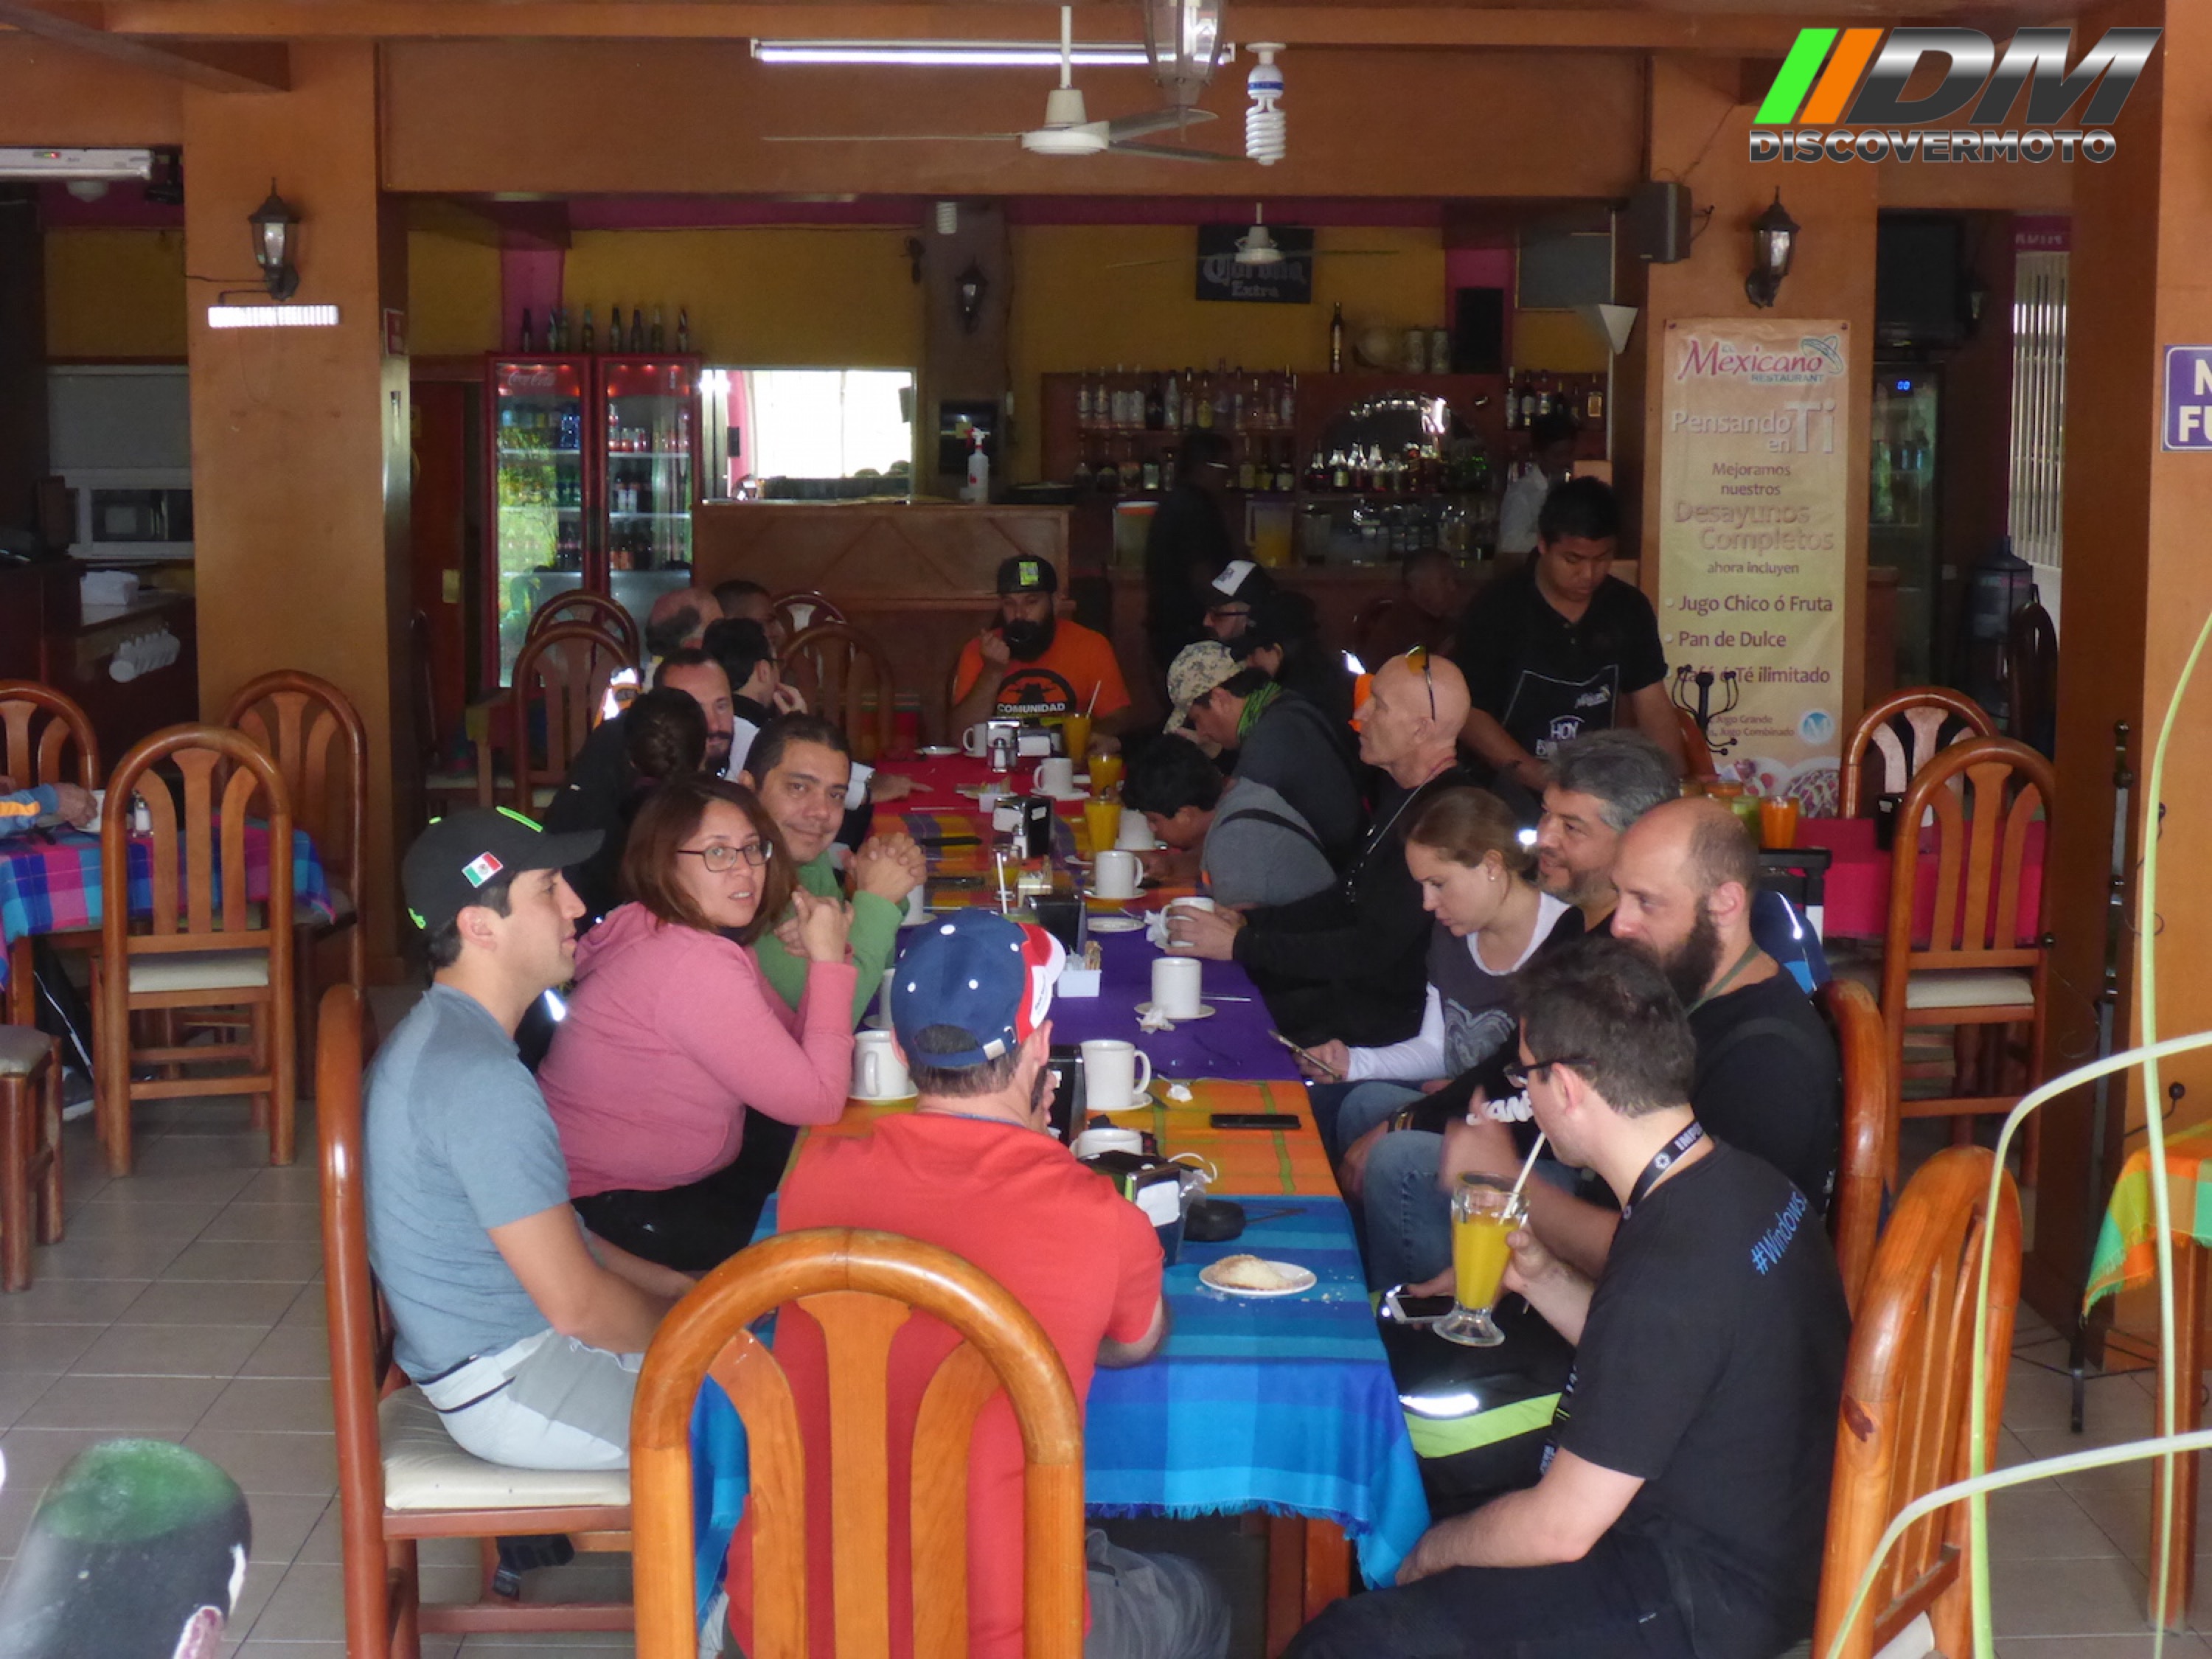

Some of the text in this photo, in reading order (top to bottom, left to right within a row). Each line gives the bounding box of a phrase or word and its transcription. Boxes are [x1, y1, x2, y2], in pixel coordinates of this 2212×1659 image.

[1231, 280, 1279, 297] Extra
[1677, 338, 1823, 380] Mexicano
[1751, 374, 1824, 383] RESTAURANT
[1671, 398, 1837, 455] Pensando en Ti
[1711, 463, 1791, 479] Mejoramos
[1720, 484, 1781, 496] nuestros
[1674, 502, 1810, 527] Desayunos
[1700, 526, 1834, 556] Completos
[1707, 562, 1800, 577] ahora incluyen
[1678, 595, 1833, 615] Jugo Chico ó Fruta
[1678, 631, 1787, 647] Pan de Dulce
[1735, 666, 1754, 683] Té
[1759, 666, 1831, 683] ilimitado
[998, 703, 1065, 713] COMUNIDAD
[1739, 714, 1773, 723] Grande
[1743, 727, 1795, 736] Combinado
